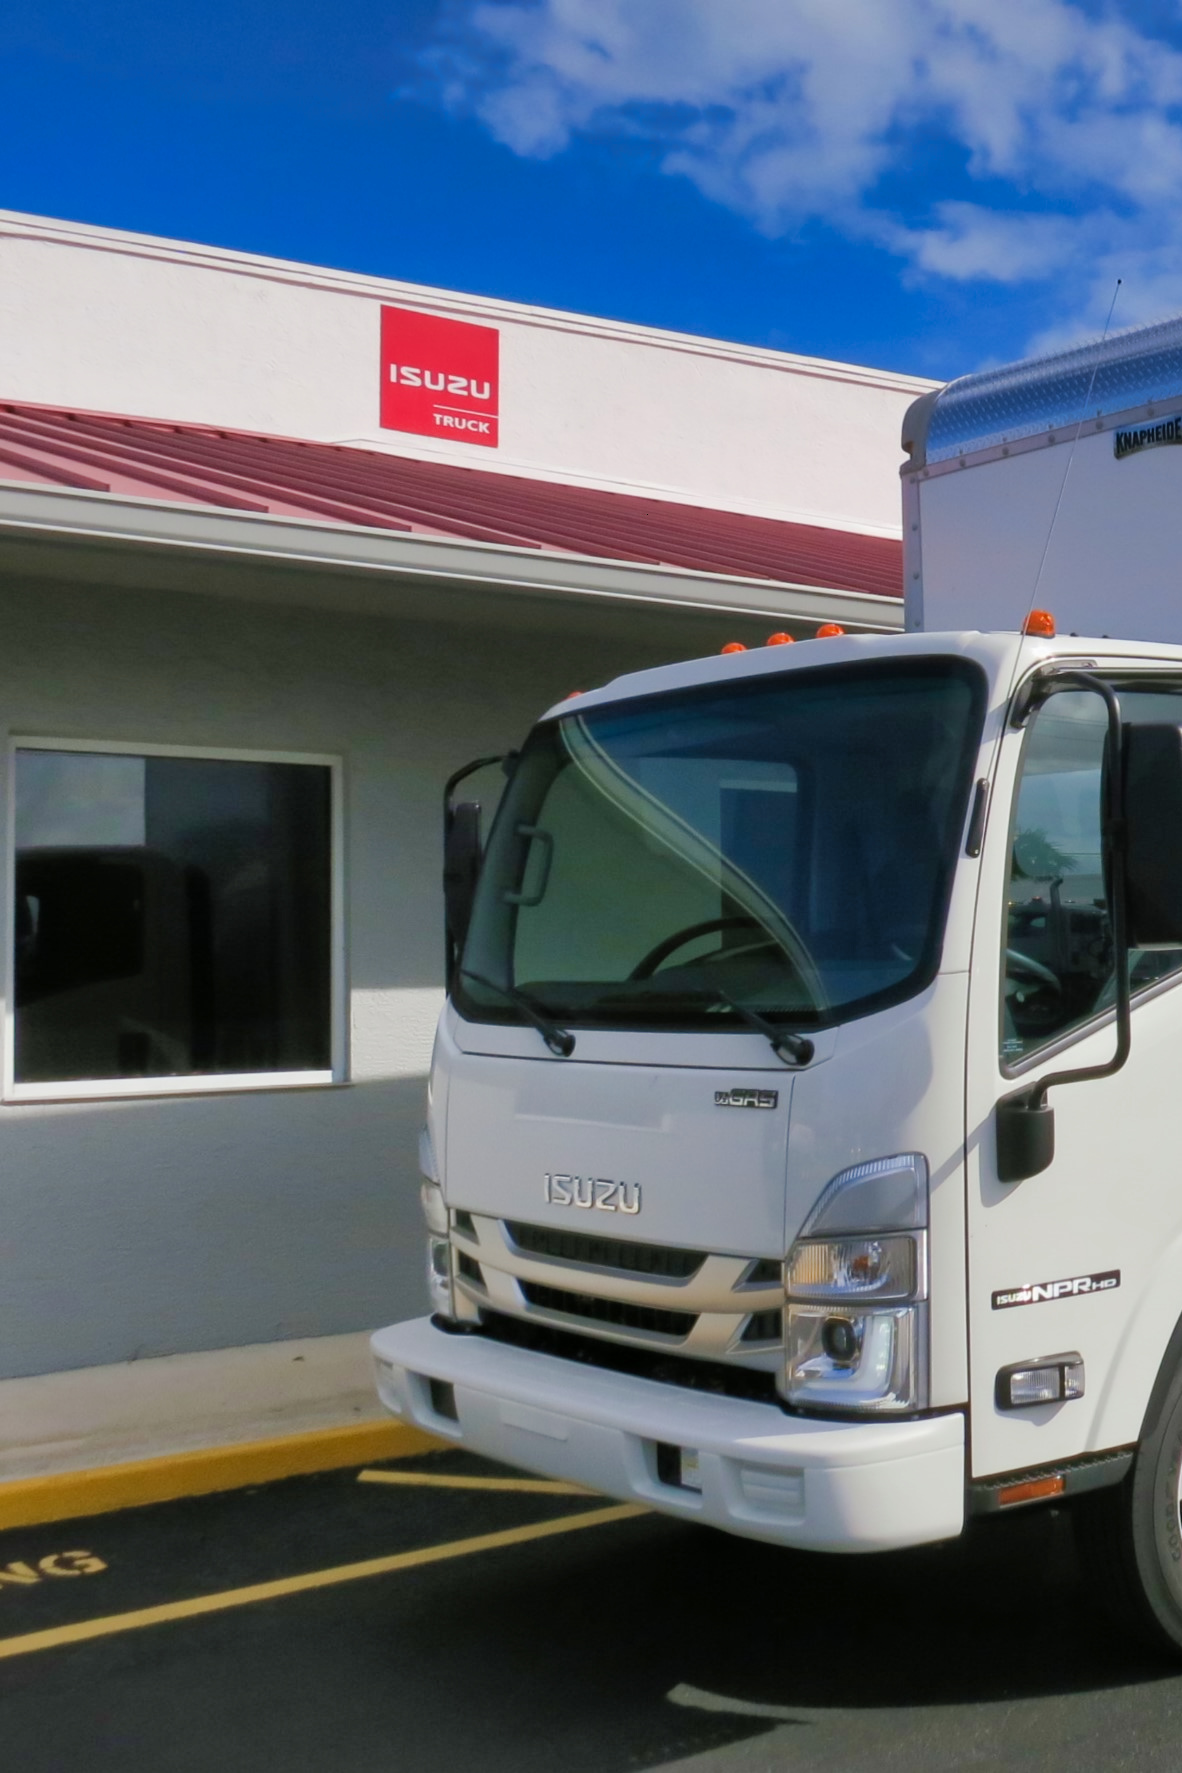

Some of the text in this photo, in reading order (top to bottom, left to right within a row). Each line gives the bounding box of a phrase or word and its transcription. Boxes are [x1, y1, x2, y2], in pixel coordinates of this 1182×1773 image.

[390, 363, 491, 400] ISUZU
[433, 413, 490, 434] TRUCK
[1115, 417, 1182, 454] KNAPHEIDE
[544, 1173, 641, 1214] ISUZU
[1033, 1278, 1091, 1301] NPR
